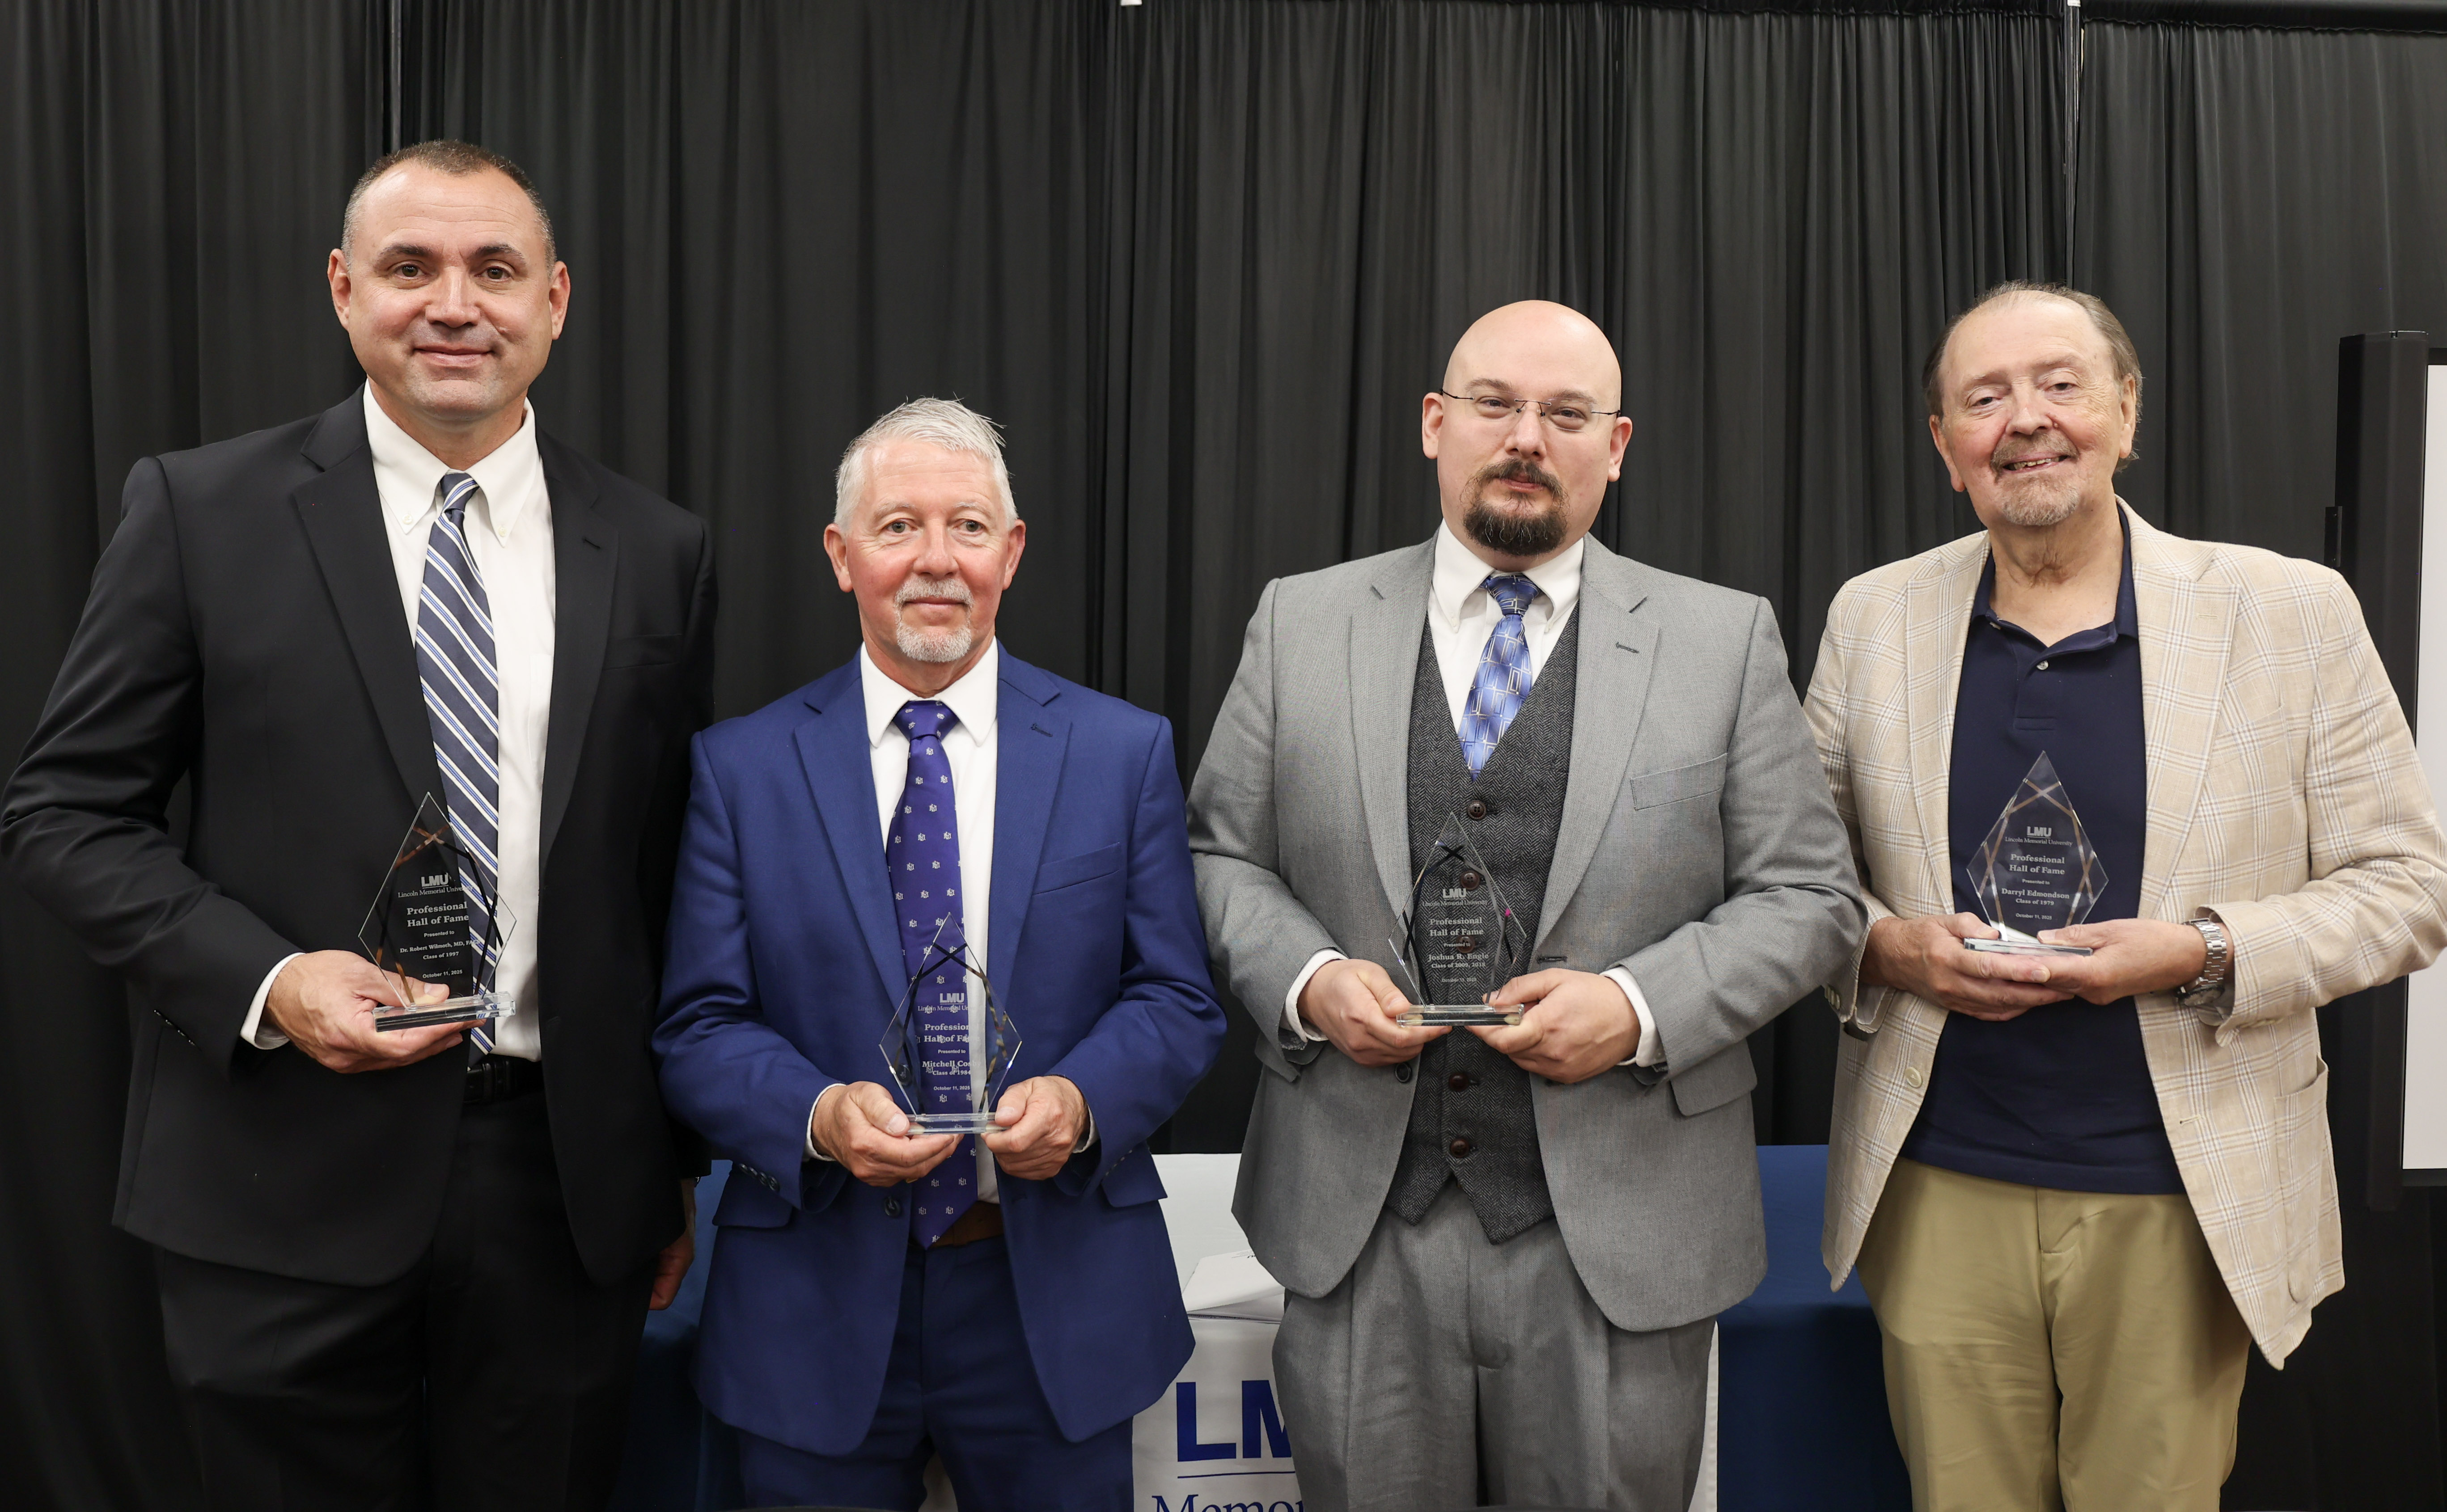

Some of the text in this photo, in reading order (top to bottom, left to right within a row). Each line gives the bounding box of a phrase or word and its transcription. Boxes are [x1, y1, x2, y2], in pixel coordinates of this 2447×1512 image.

[2027, 826, 2052, 837] LMU
[2011, 854, 2065, 864] Professional
[421, 874, 449, 887] LMU
[1443, 888, 1466, 898] LMU
[2002, 888, 2069, 899] Darryl Edmondson
[407, 902, 468, 915] Professional
[407, 918, 428, 927] Hall
[431, 916, 442, 924] of
[1427, 954, 1454, 962] Joshua
[940, 993, 964, 1003] LMU
